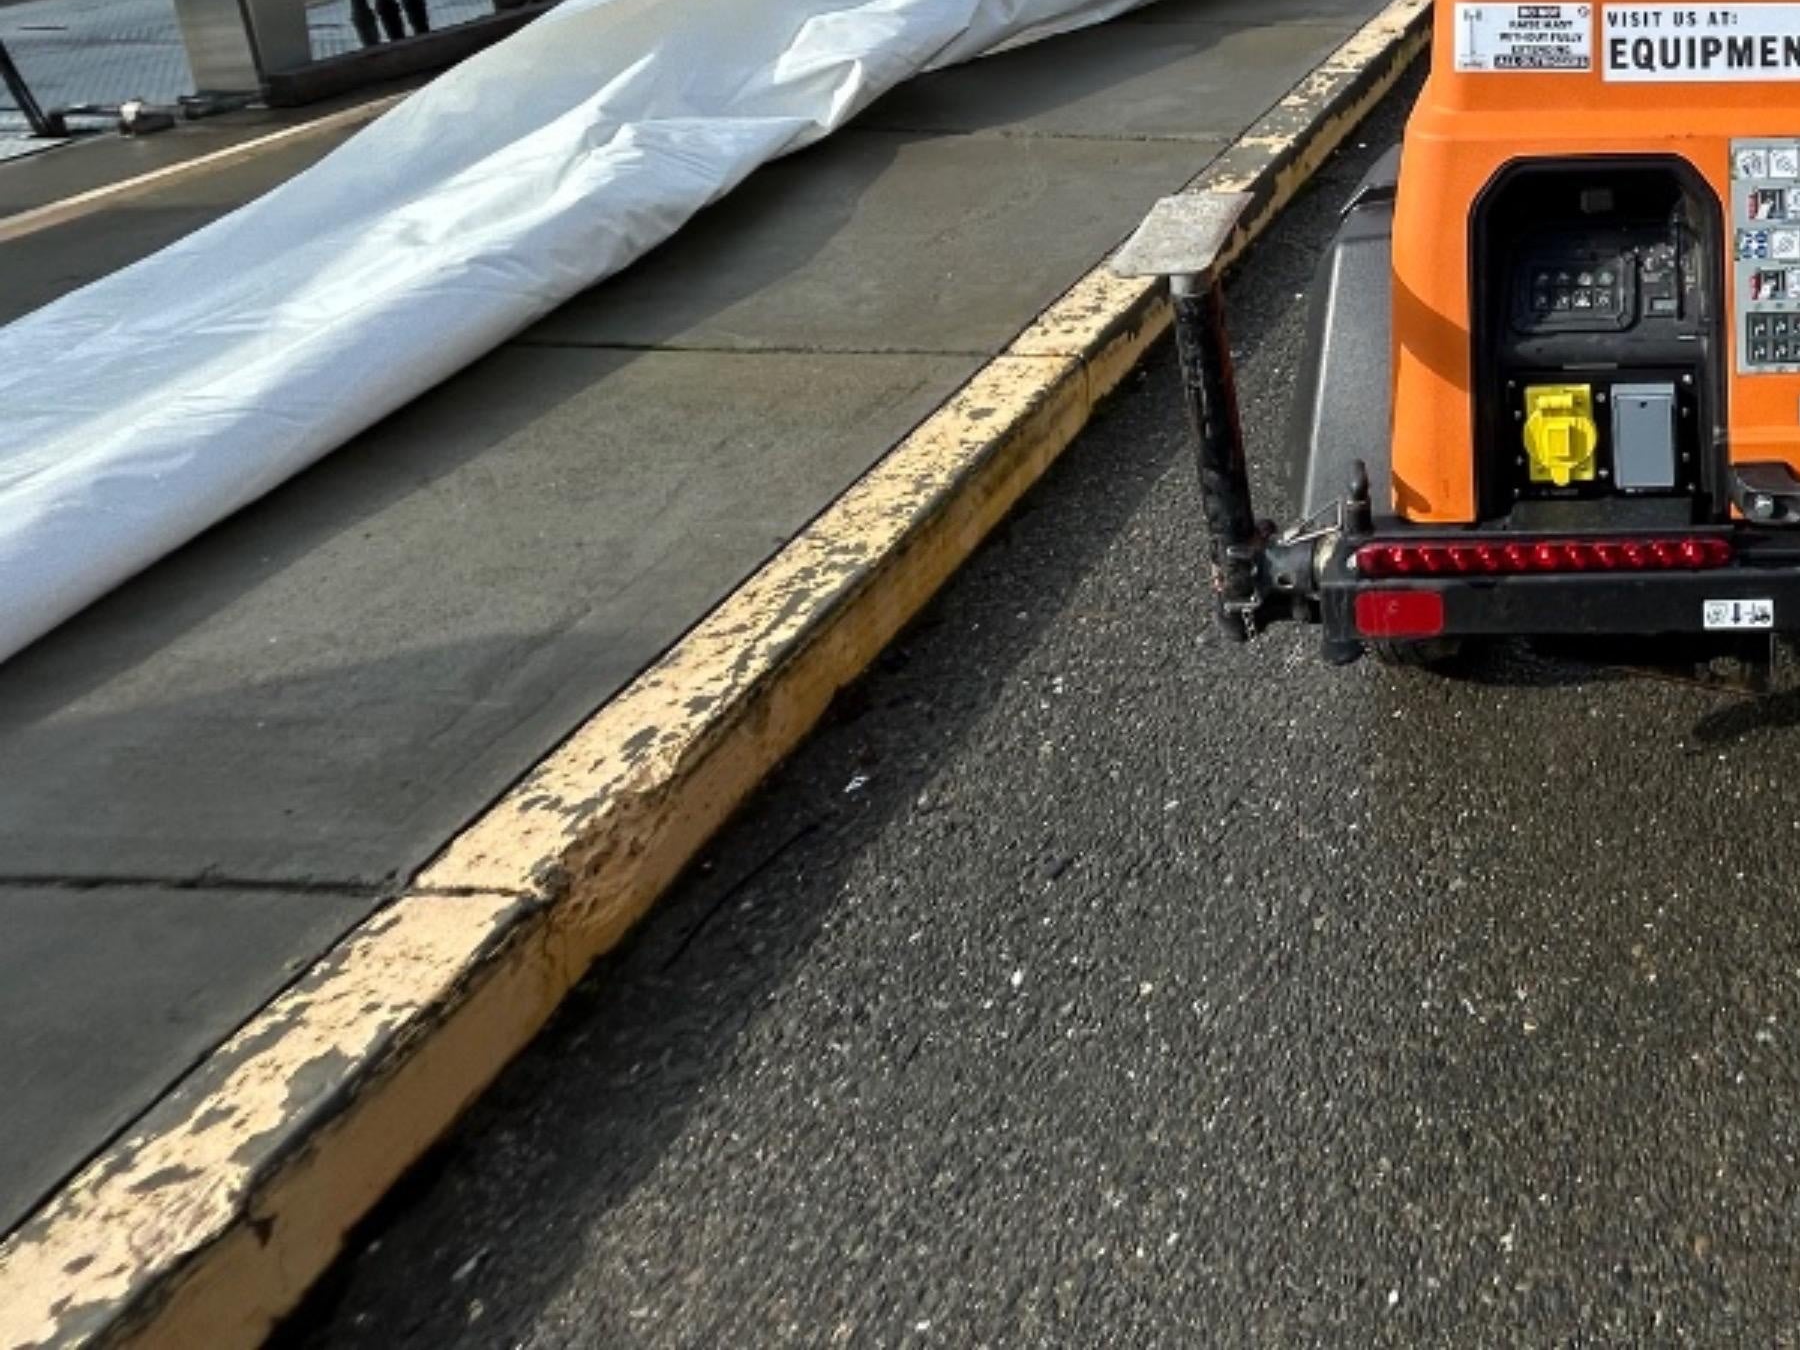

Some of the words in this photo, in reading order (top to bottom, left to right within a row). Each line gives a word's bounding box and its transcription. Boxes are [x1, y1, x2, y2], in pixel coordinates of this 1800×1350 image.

[1607, 11, 1662, 28] VISIT
[1673, 11, 1696, 28] US
[1707, 11, 1738, 27] AT:
